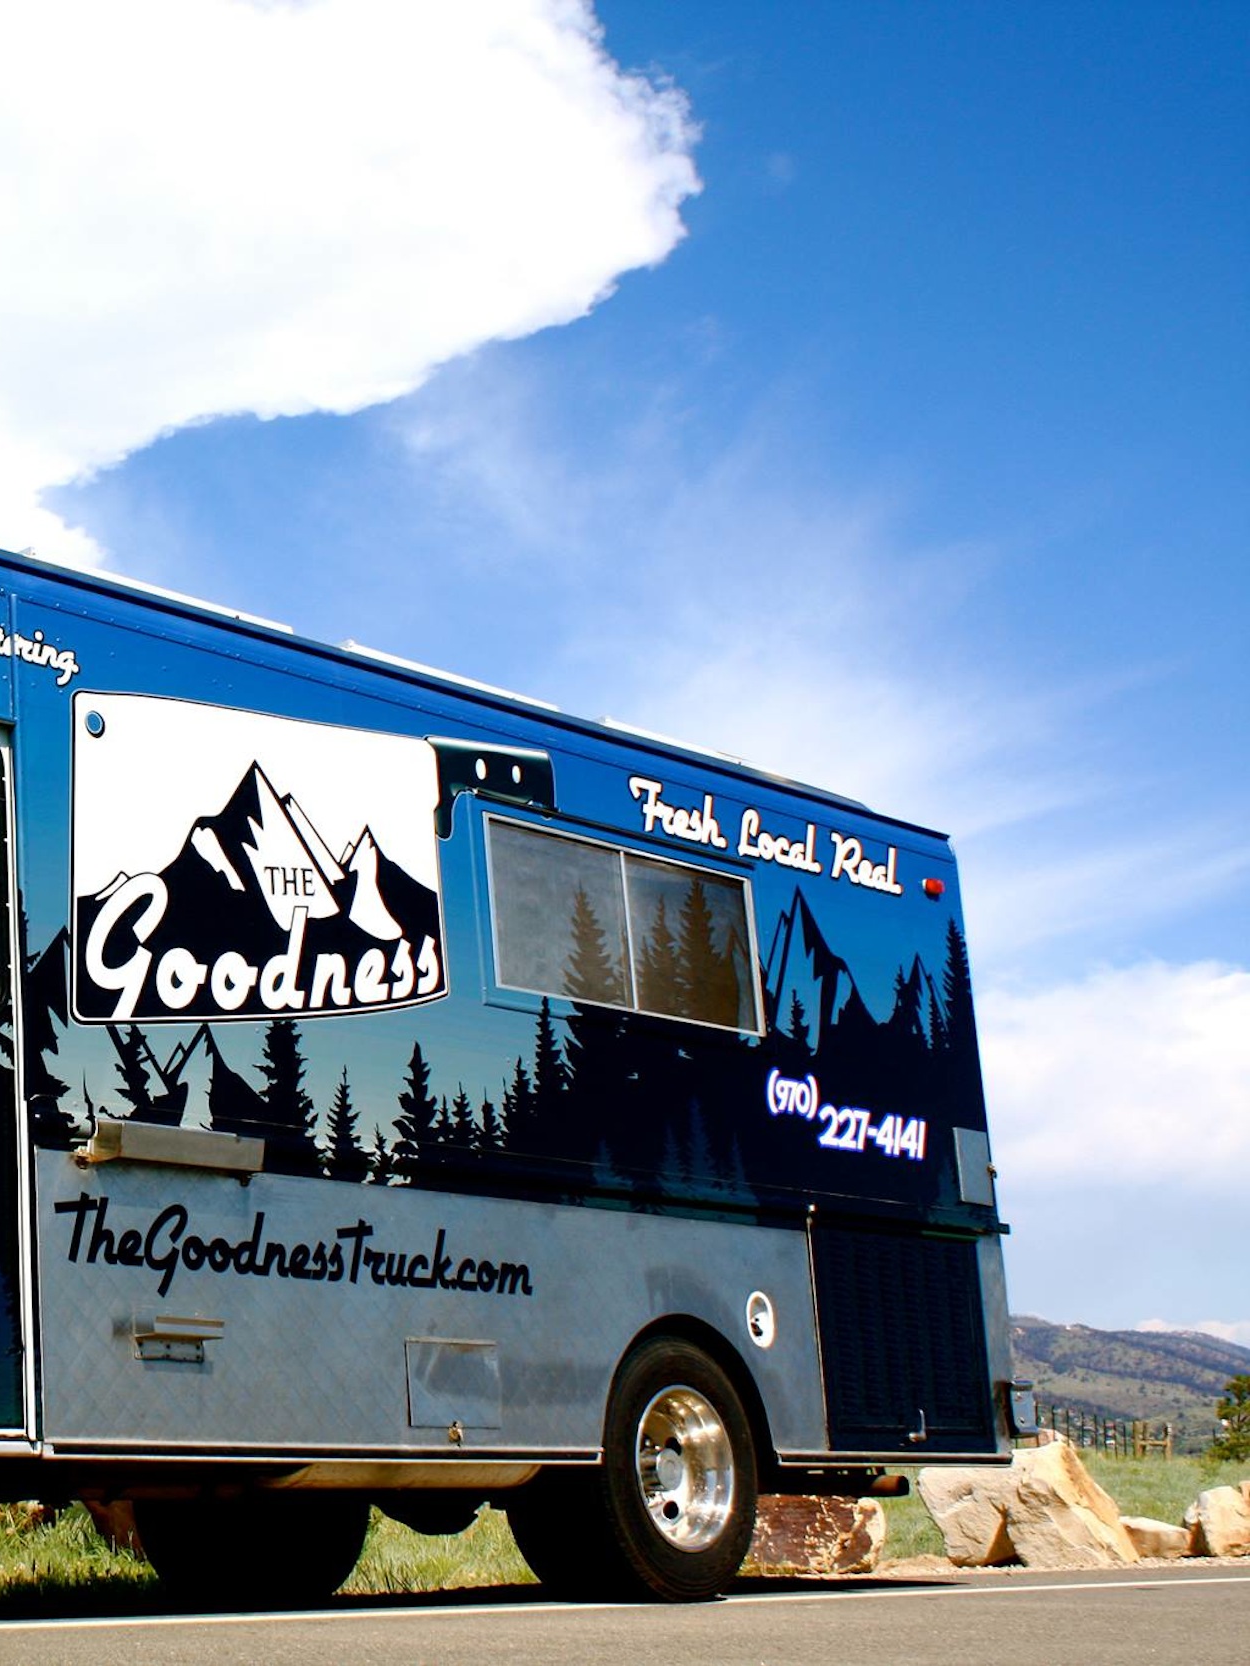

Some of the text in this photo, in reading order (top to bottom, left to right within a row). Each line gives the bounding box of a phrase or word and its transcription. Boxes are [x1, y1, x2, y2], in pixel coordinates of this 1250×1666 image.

[629, 776, 903, 894] Fresh Local Real
[263, 866, 315, 896] THE
[85, 872, 440, 1019] Goodness
[767, 1069, 818, 1120] (970)
[818, 1104, 926, 1159] 227-4141
[54, 1193, 533, 1298] TheGoodnessTruck.com
